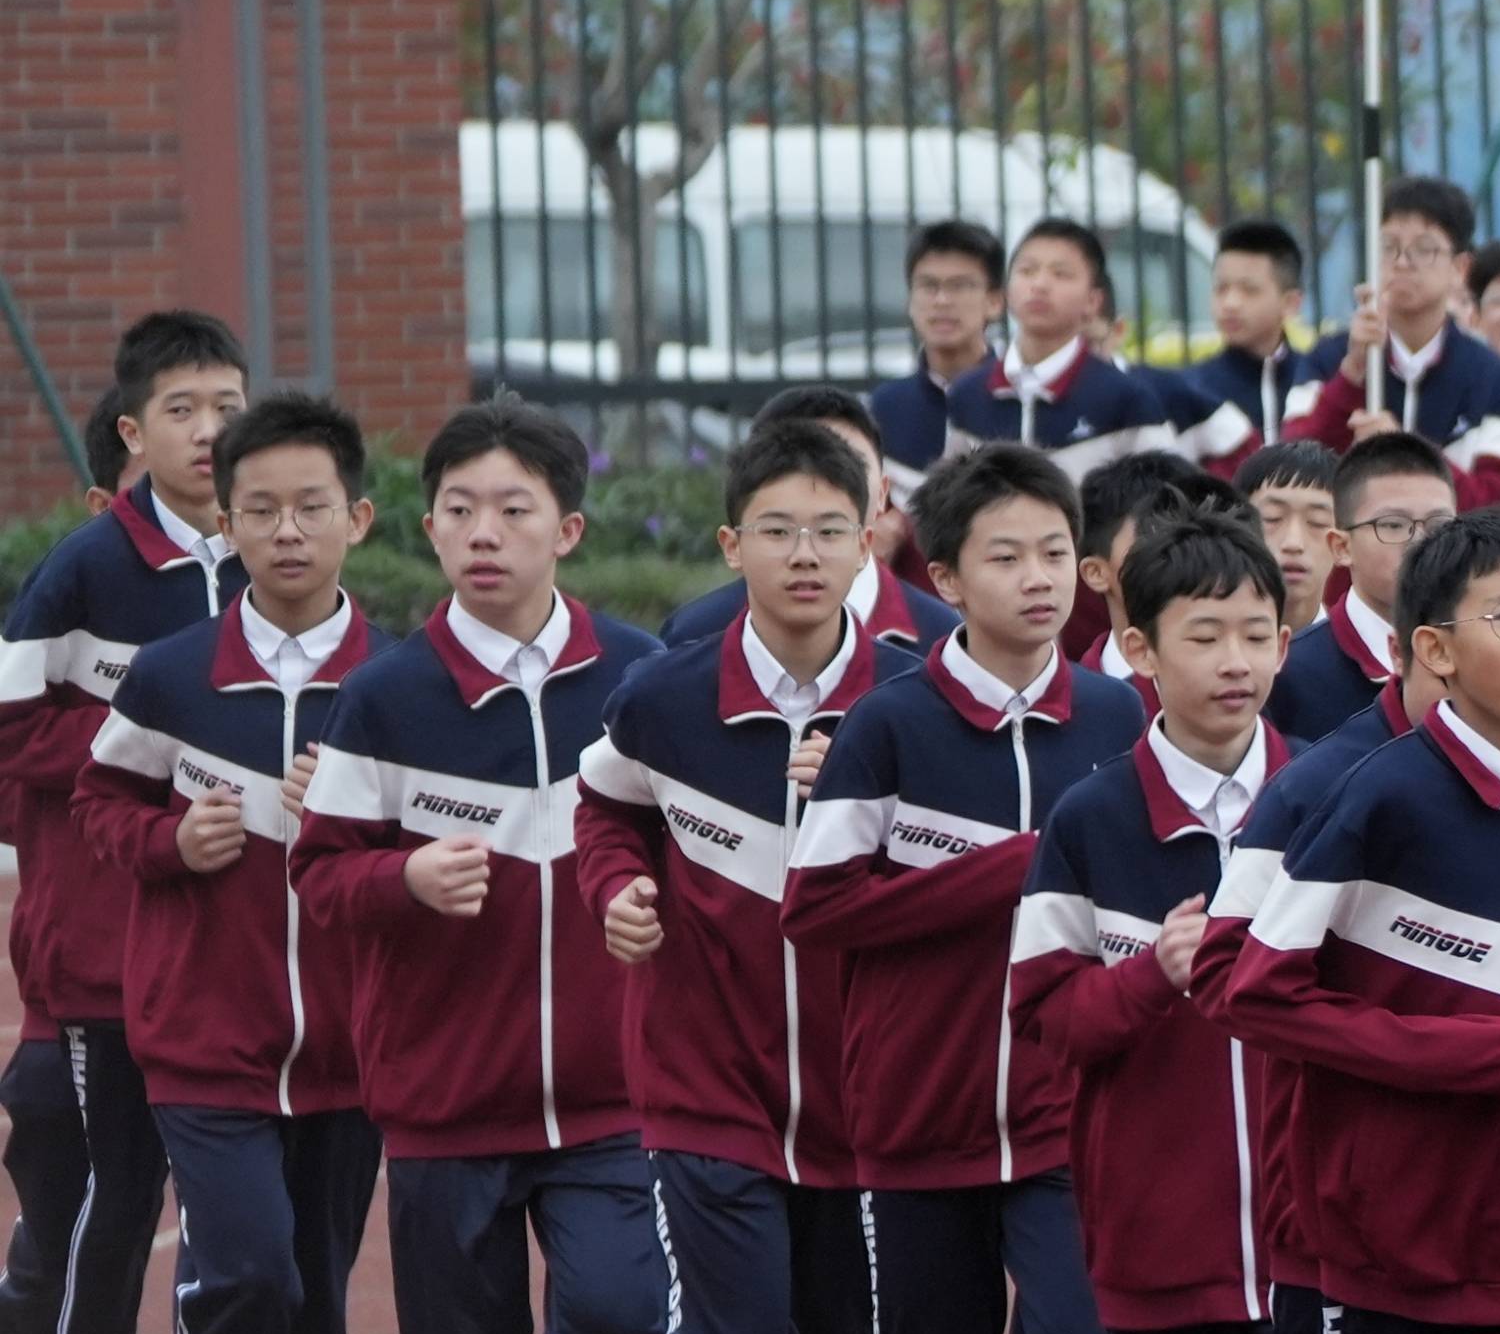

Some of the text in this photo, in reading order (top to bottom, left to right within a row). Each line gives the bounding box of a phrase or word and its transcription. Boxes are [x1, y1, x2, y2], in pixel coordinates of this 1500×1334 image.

[411, 791, 504, 826] MINGDE
[667, 803, 744, 852] MINGDE
[1389, 915, 1493, 964] MINGDE
